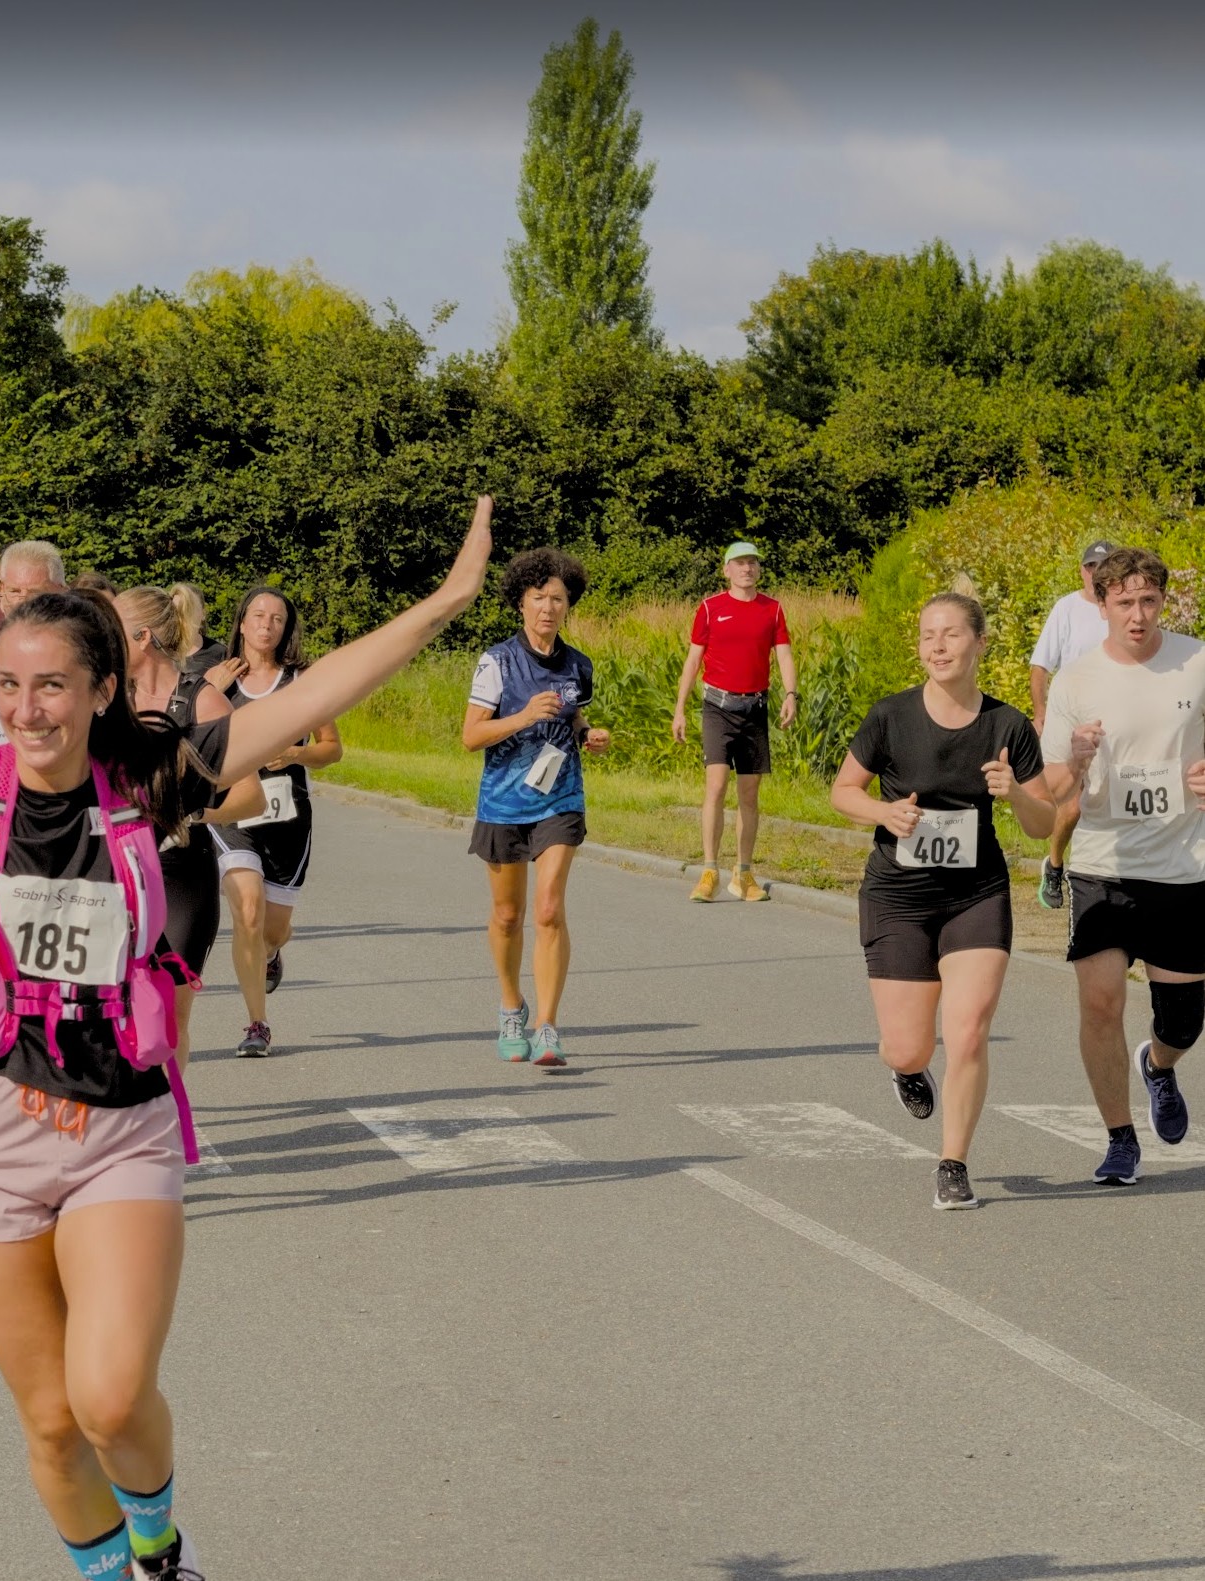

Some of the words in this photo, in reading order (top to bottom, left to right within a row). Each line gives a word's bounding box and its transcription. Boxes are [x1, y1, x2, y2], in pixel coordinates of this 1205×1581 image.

[1125, 786, 1169, 816] 403
[914, 836, 960, 864] 402
[12, 887, 52, 903] Sabhi
[69, 895, 107, 907] sport
[17, 921, 90, 976] 185
